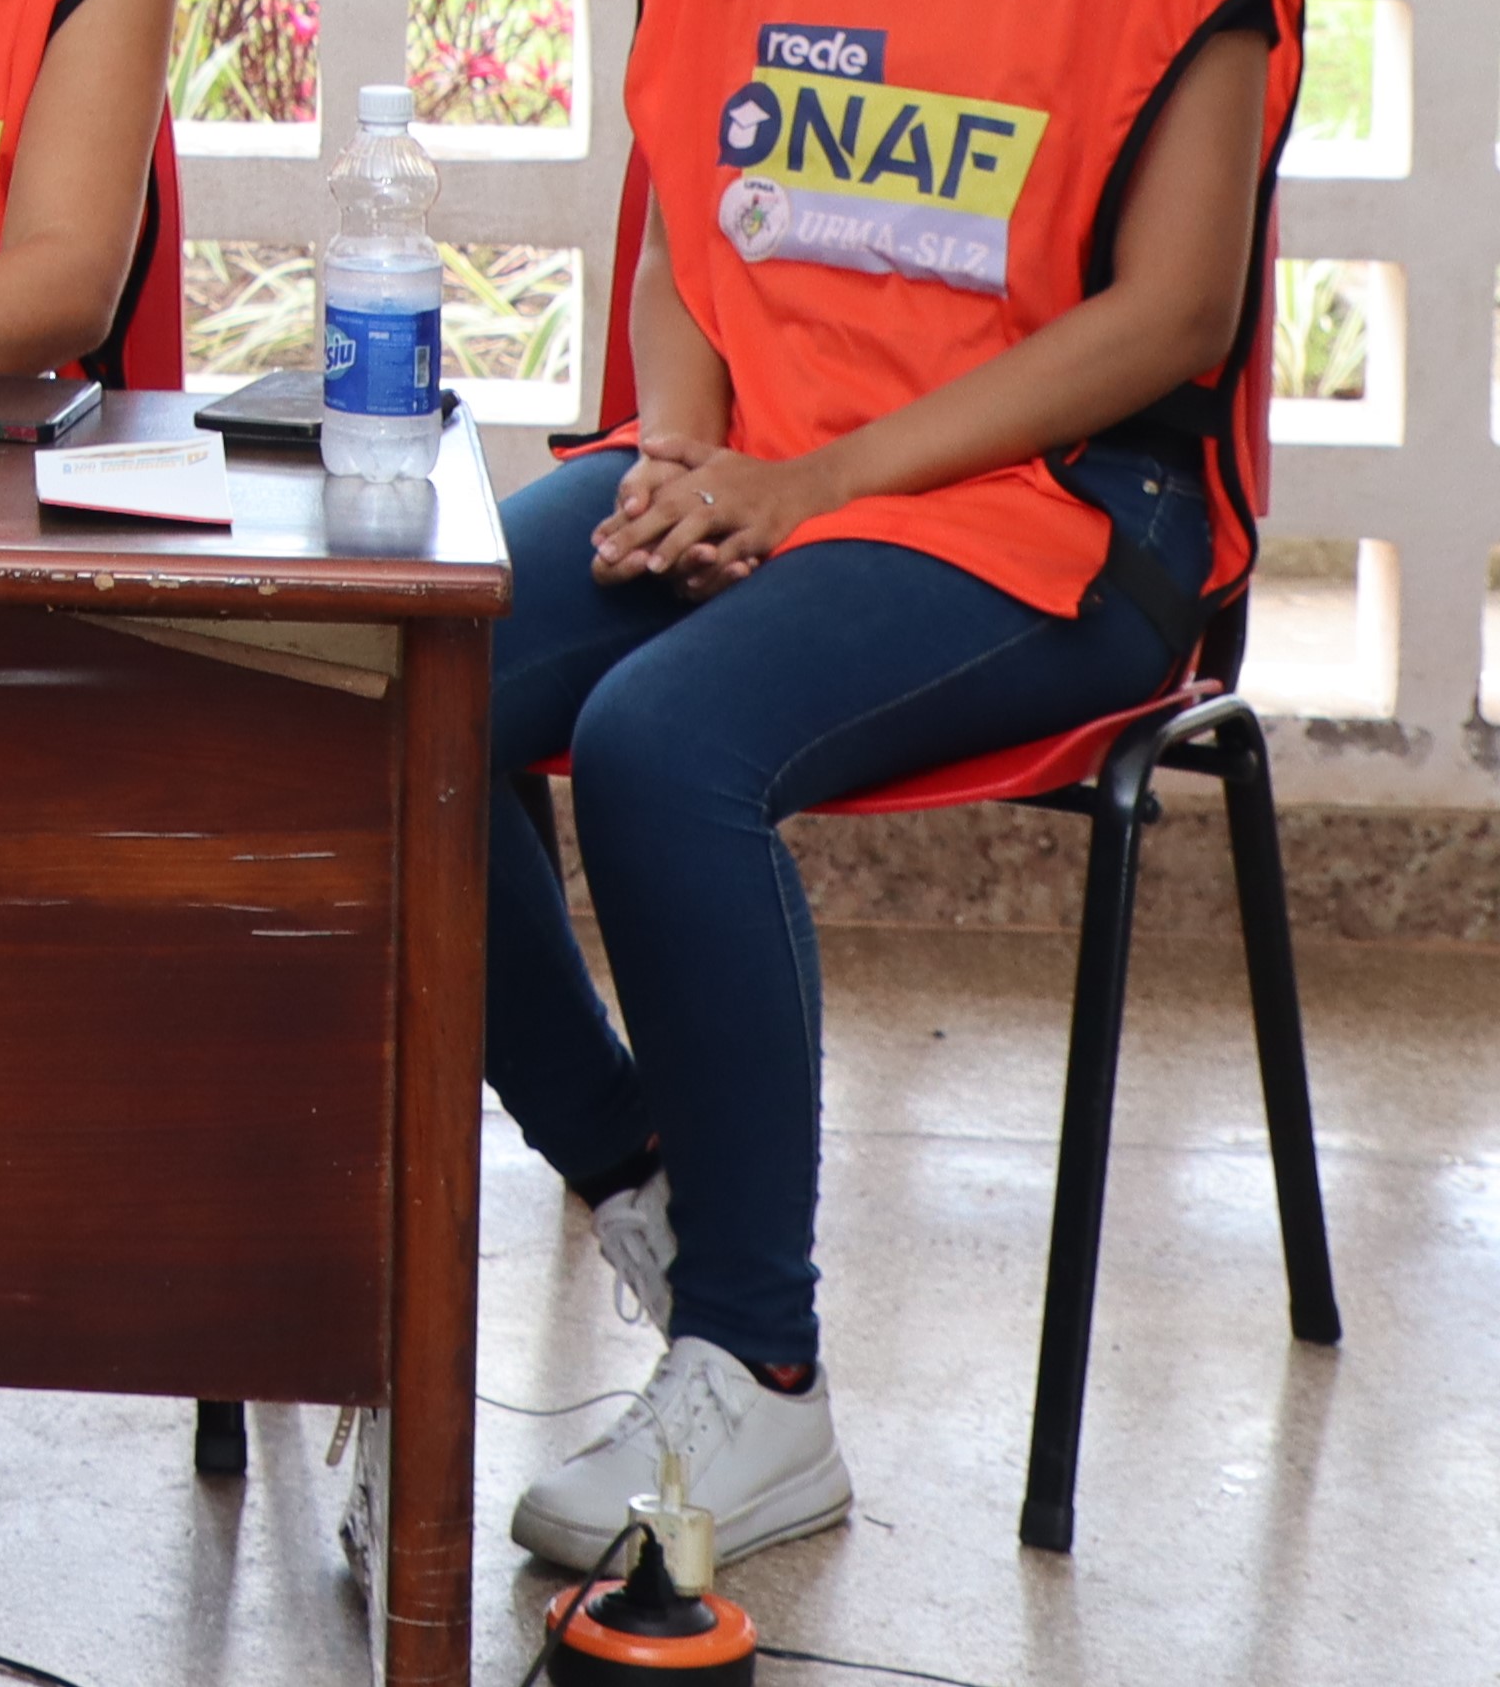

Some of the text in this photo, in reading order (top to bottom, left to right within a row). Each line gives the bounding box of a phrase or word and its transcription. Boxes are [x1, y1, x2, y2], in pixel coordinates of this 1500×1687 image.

[767, 31, 868, 76] rede
[787, 86, 1016, 200] NAF
[797, 209, 991, 277] UFMA-SLZ
